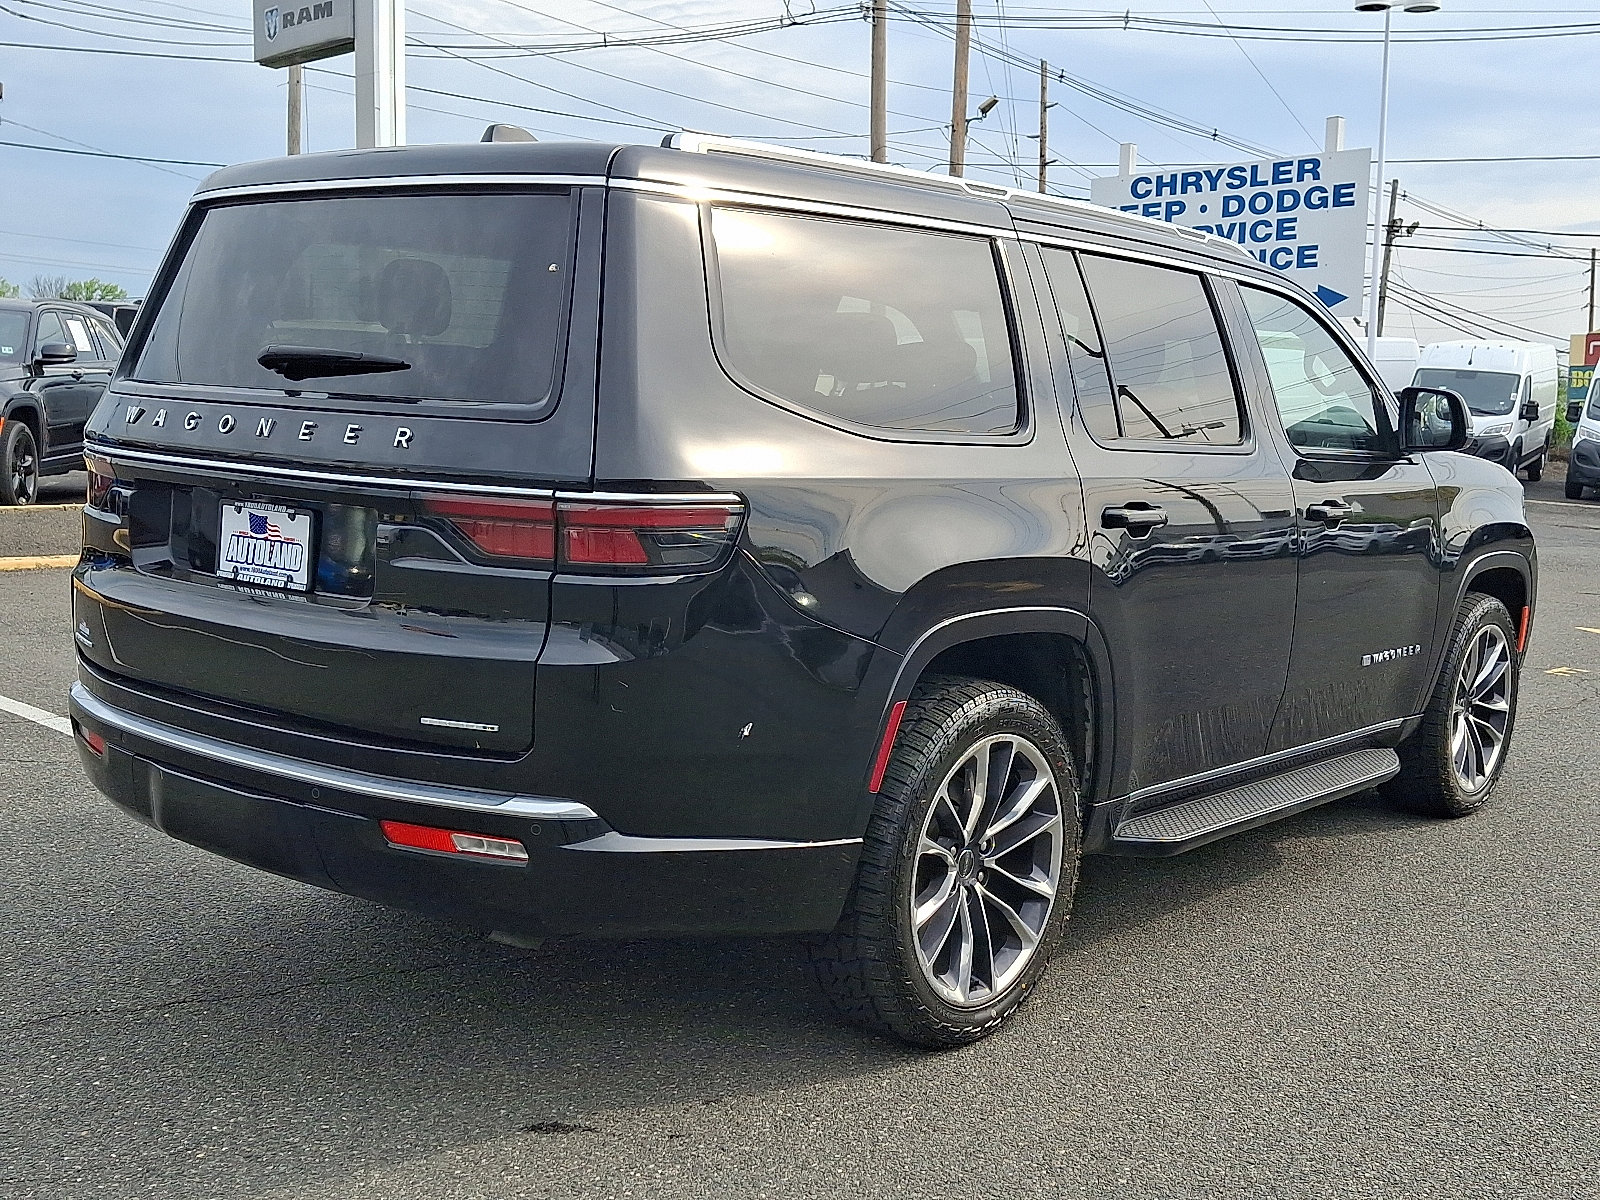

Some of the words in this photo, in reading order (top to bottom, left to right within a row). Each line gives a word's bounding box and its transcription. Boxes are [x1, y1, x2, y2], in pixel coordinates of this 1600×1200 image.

[282, 1, 333, 29] RAM
[1130, 158, 1322, 200] CHRYSLER
[1109, 200, 1187, 223] EP
[1221, 183, 1356, 218] DODGE
[125, 404, 413, 448] WAGONEER
[226, 535, 304, 572] AUTOLAND
[237, 574, 285, 588] AUTOLAND
